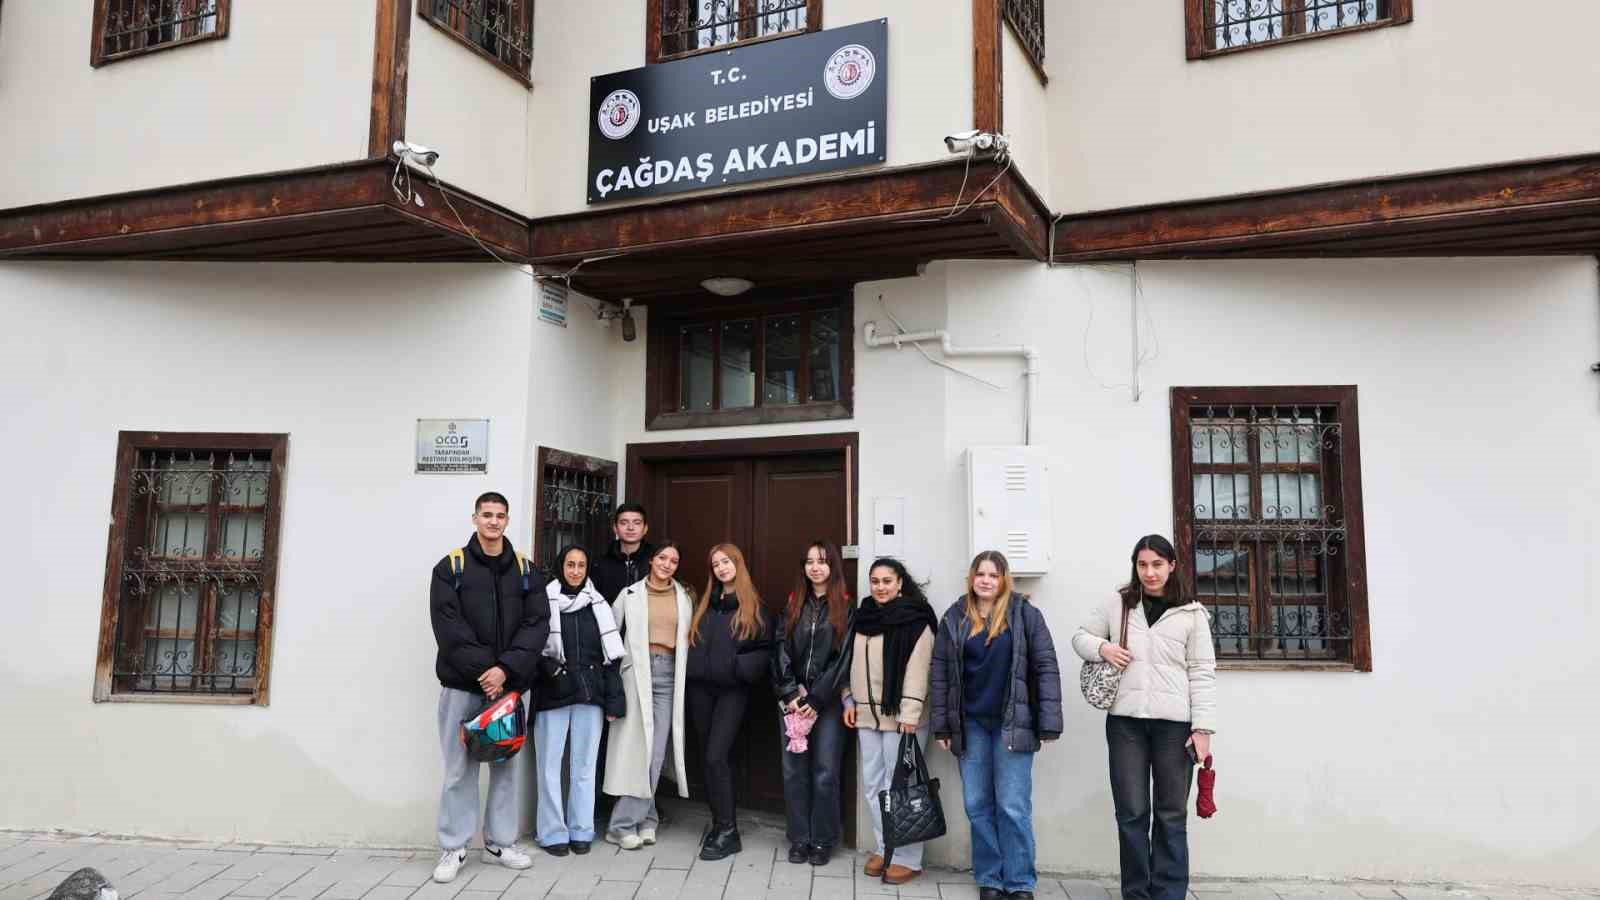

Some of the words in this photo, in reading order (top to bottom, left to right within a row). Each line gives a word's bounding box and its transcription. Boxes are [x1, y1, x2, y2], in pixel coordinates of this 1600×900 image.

[711, 67, 747, 86] T.C.
[648, 111, 695, 134] UŞAK
[705, 87, 814, 124] BELEDİYESİ
[595, 153, 714, 197] ÇAĞDAŞ
[722, 121, 875, 175] AKADEMİ
